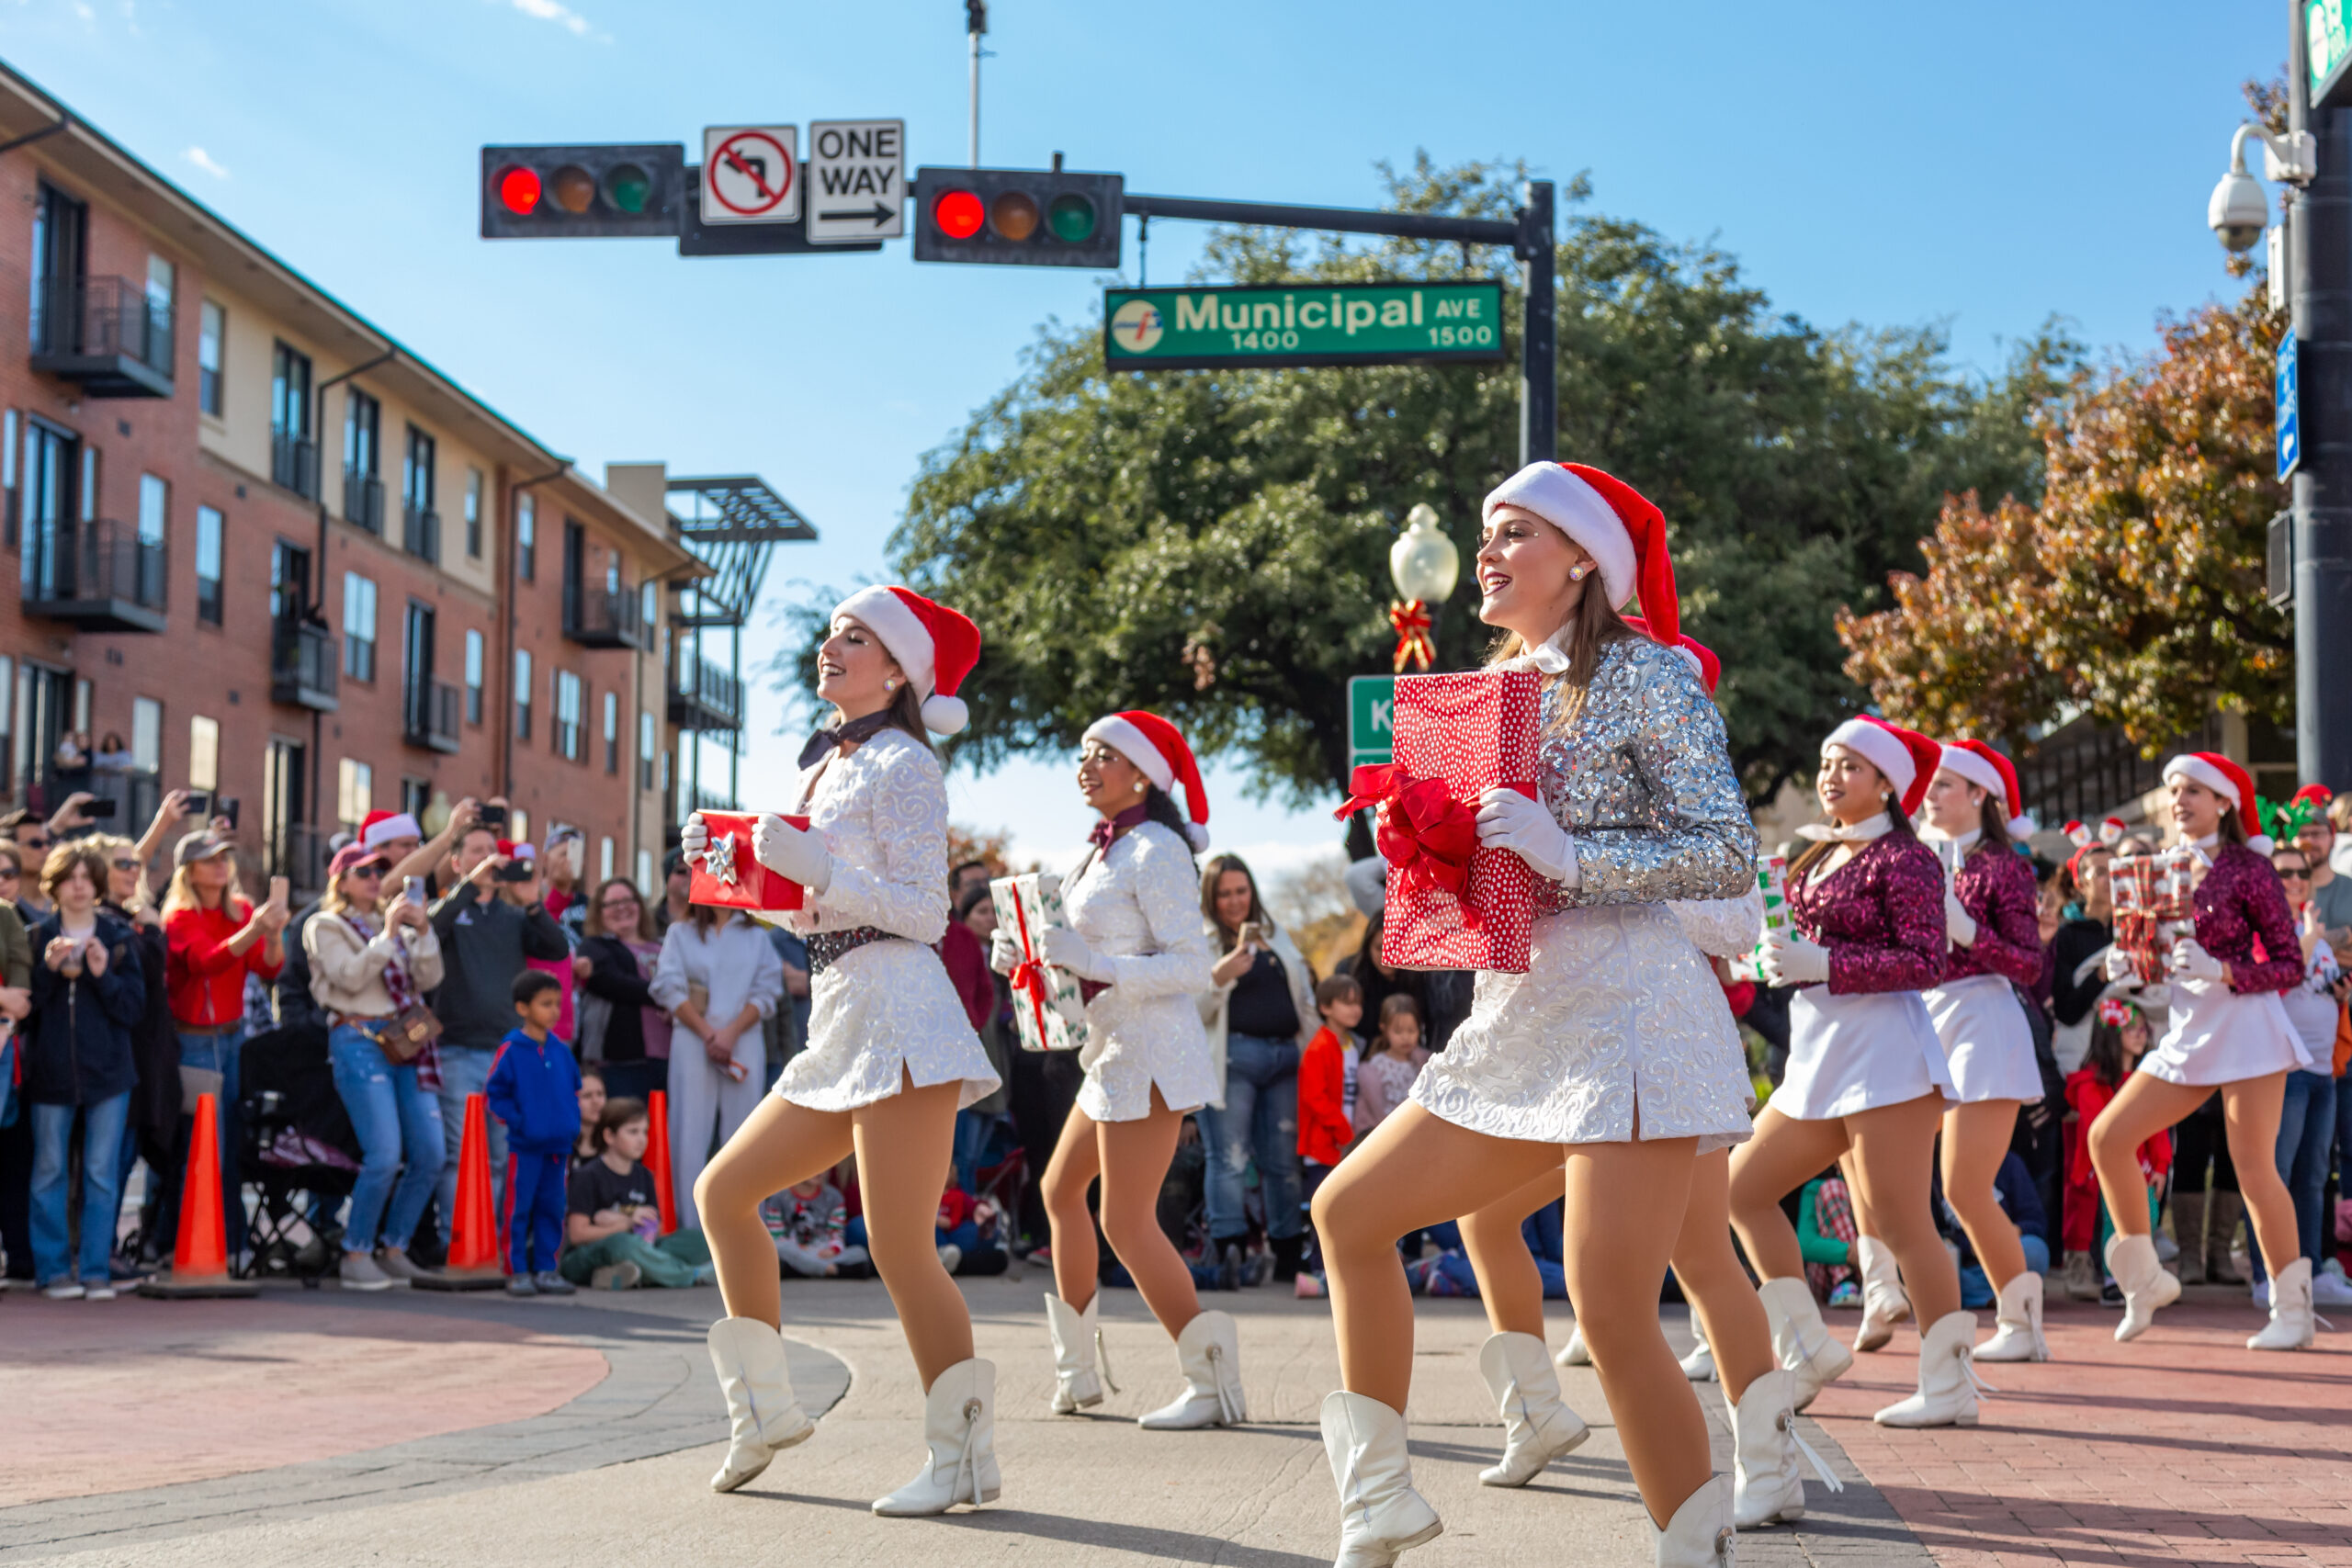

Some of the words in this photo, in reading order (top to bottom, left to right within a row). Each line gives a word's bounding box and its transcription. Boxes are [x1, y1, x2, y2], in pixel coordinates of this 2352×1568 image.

[817, 129, 899, 159] ONE
[820, 165, 896, 197] WAY
[1174, 290, 1424, 336] Municipal
[1435, 298, 1482, 320] AVE
[1231, 331, 1299, 351] 1400
[1429, 325, 1492, 347] 1500
